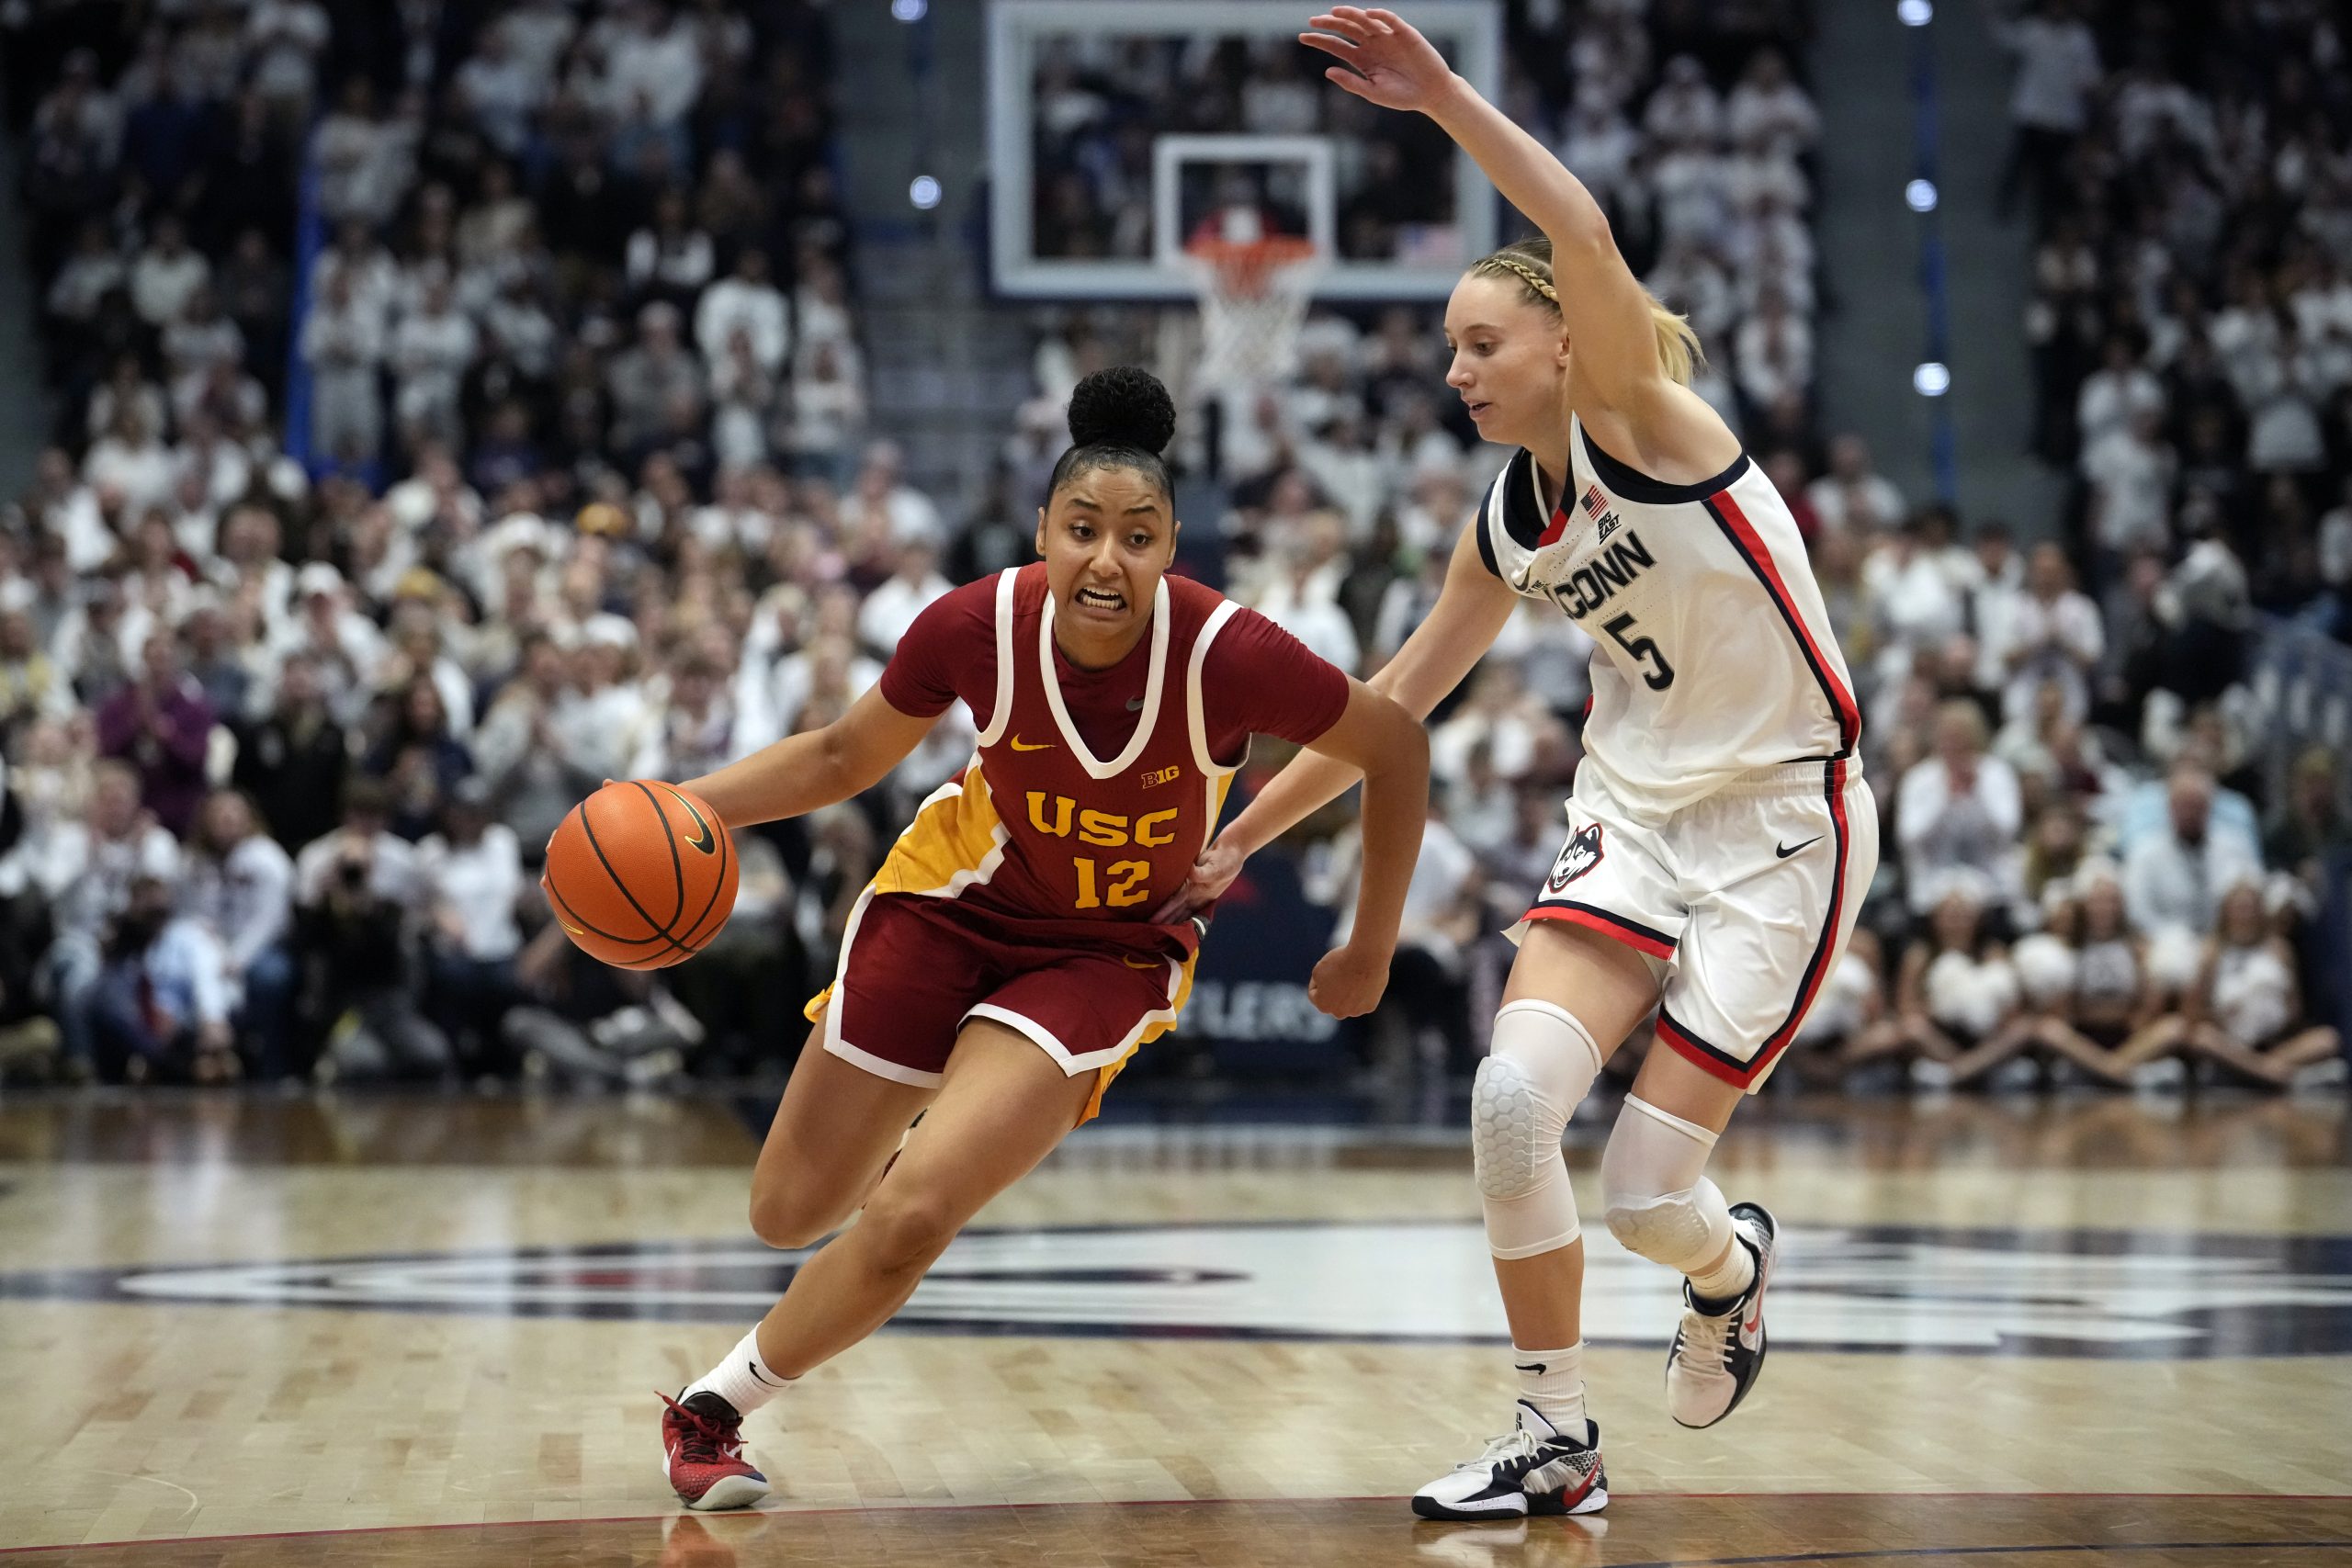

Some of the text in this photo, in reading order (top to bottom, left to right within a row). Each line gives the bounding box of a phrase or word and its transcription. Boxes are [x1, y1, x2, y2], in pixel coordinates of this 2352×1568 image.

[1598, 511, 1611, 530] BIG
[1599, 514, 1619, 539] EAST
[1601, 611, 1675, 692] 5
[1025, 791, 1178, 849] USC
[1074, 856, 1150, 909] 12
